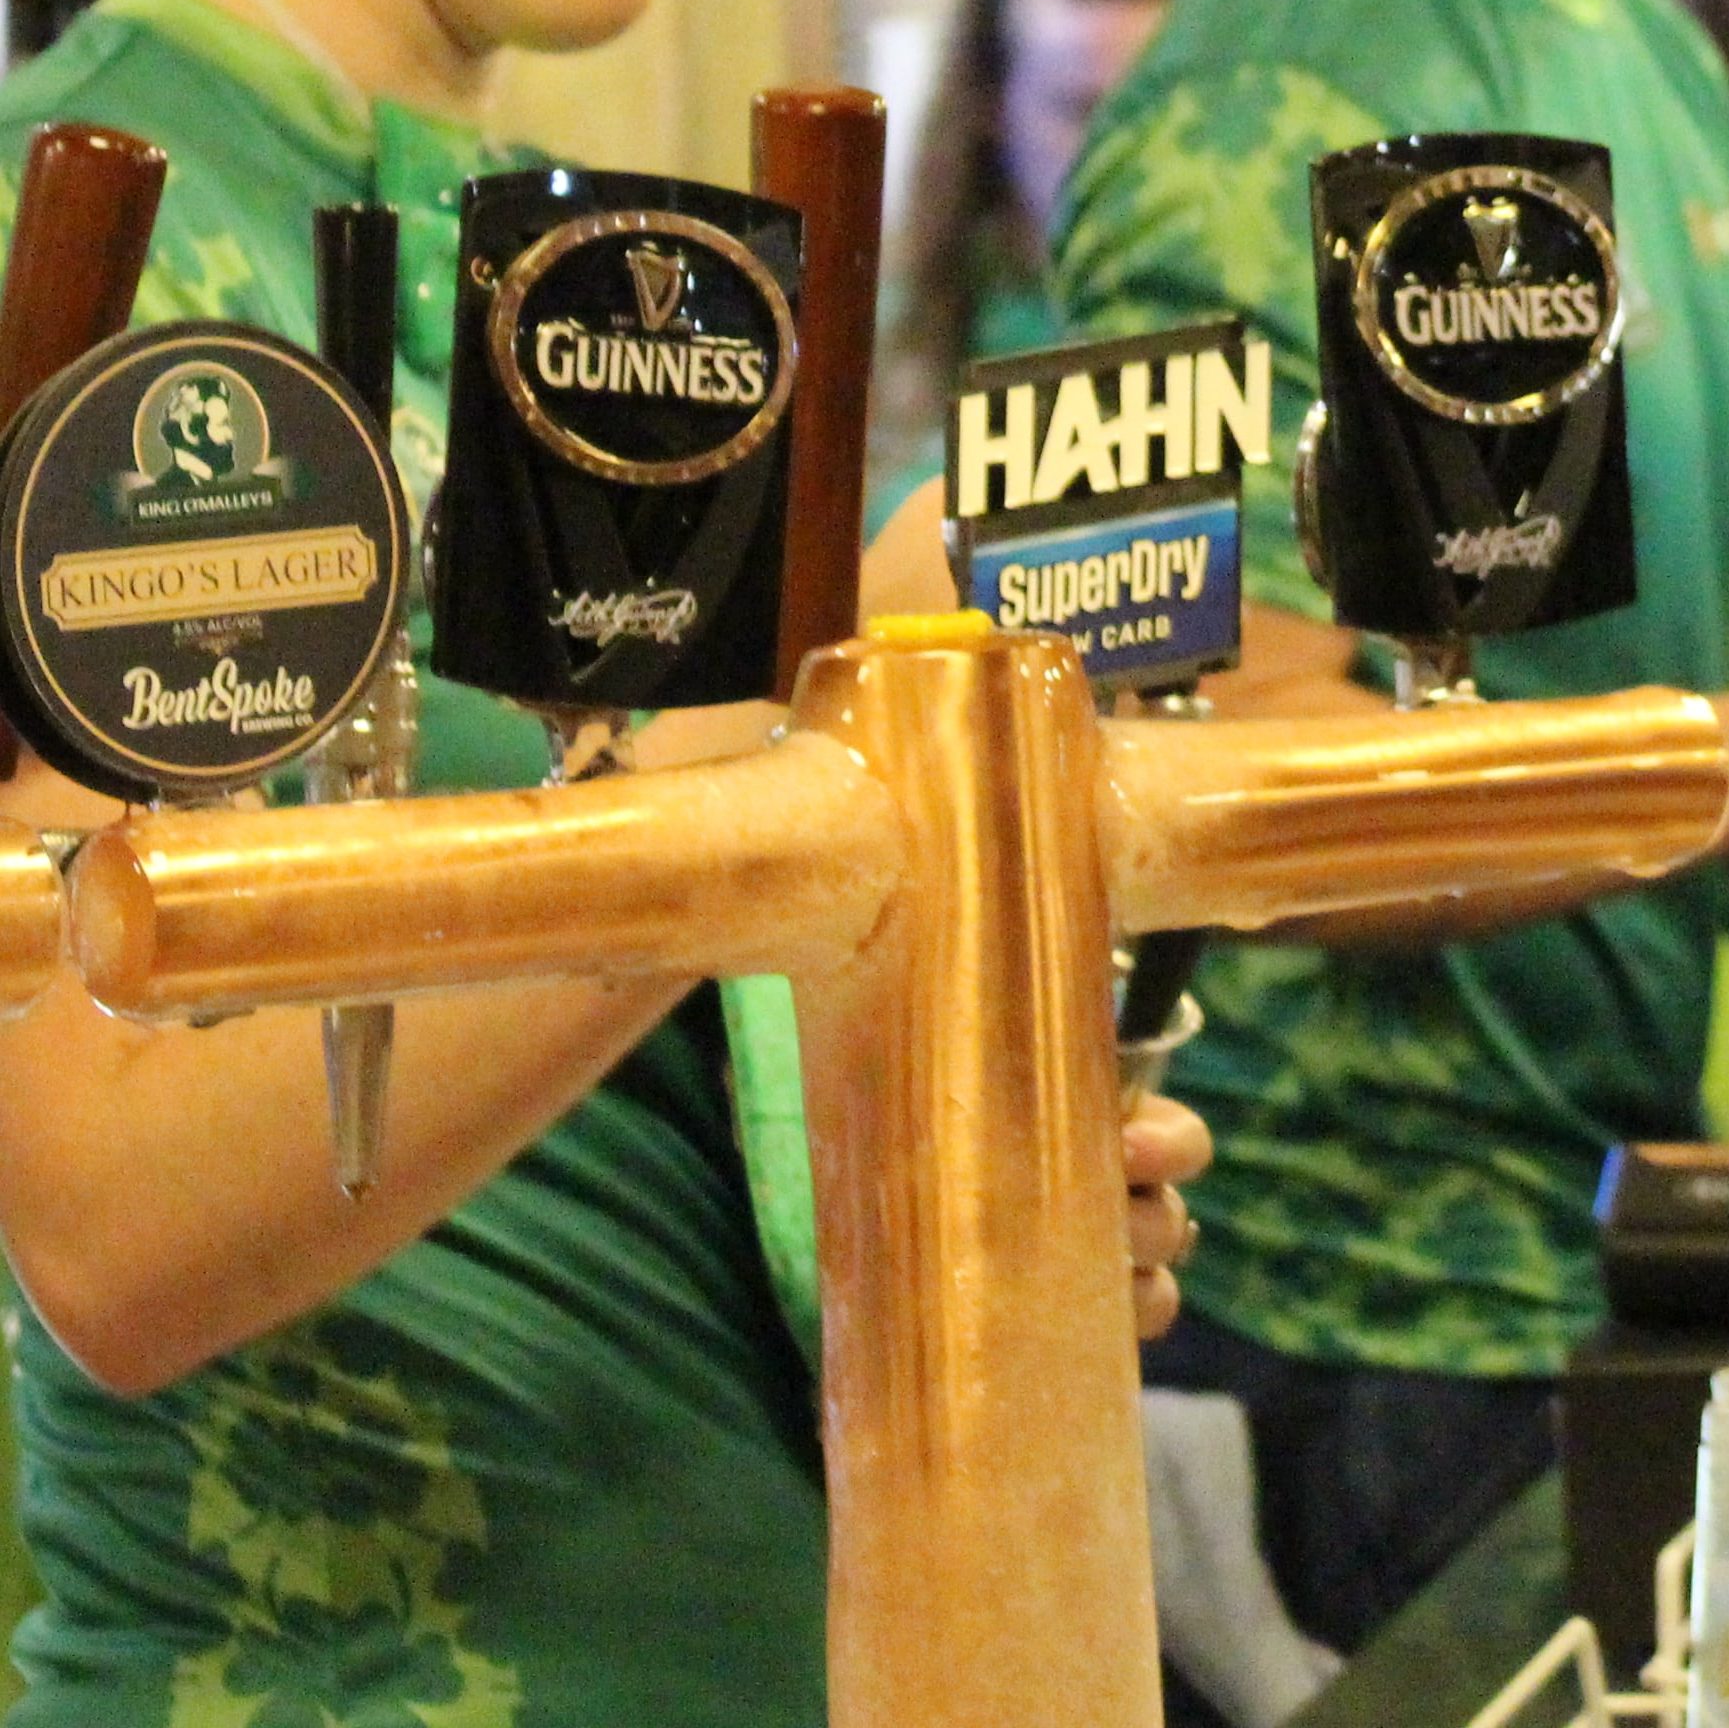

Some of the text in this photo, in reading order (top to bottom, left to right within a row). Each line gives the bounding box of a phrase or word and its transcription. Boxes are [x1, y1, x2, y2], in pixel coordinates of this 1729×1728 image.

[1394, 280, 1600, 346] GUINNESS
[536, 317, 765, 404] GUINNESS
[957, 340, 1272, 518] HAHN
[59, 547, 359, 610] KINGO'S LAGER
[999, 533, 1210, 628] SuperDry
[1101, 613, 1173, 651] CARB
[121, 657, 316, 735] BentSpoke
